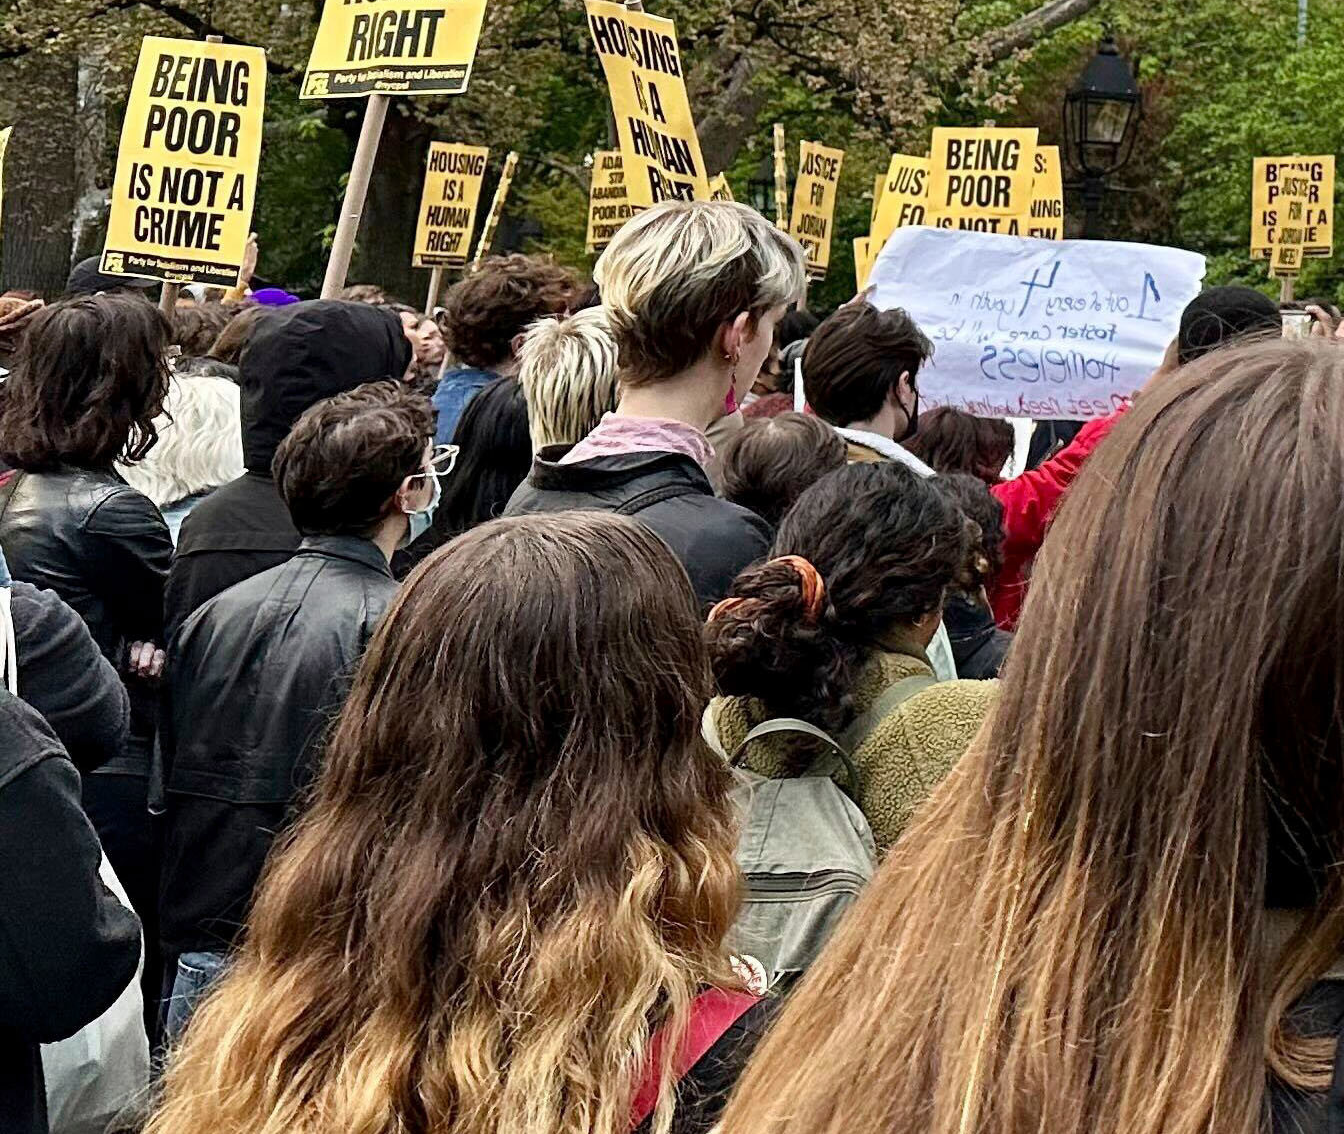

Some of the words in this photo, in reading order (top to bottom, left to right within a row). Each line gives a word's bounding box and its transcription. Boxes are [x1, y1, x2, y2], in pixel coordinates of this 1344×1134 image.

[346, 9, 445, 62] RIGHT
[590, 14, 680, 78] HOUSING
[149, 53, 249, 107] BEING
[648, 82, 667, 124] A
[143, 105, 241, 157] POOR
[429, 150, 485, 176] HOUSING
[946, 138, 1020, 171] BEING
[128, 162, 153, 200] IS
[159, 166, 224, 207] NOT
[227, 174, 245, 211] A
[442, 179, 457, 201] IS
[457, 180, 465, 202] A
[946, 175, 1011, 208] POOR
[134, 205, 225, 251] CRIME
[426, 205, 471, 229] HUMAN
[899, 202, 925, 226] FO
[1262, 210, 1277, 226] IS
[1317, 209, 1327, 225] A
[426, 230, 464, 253] RIGHT
